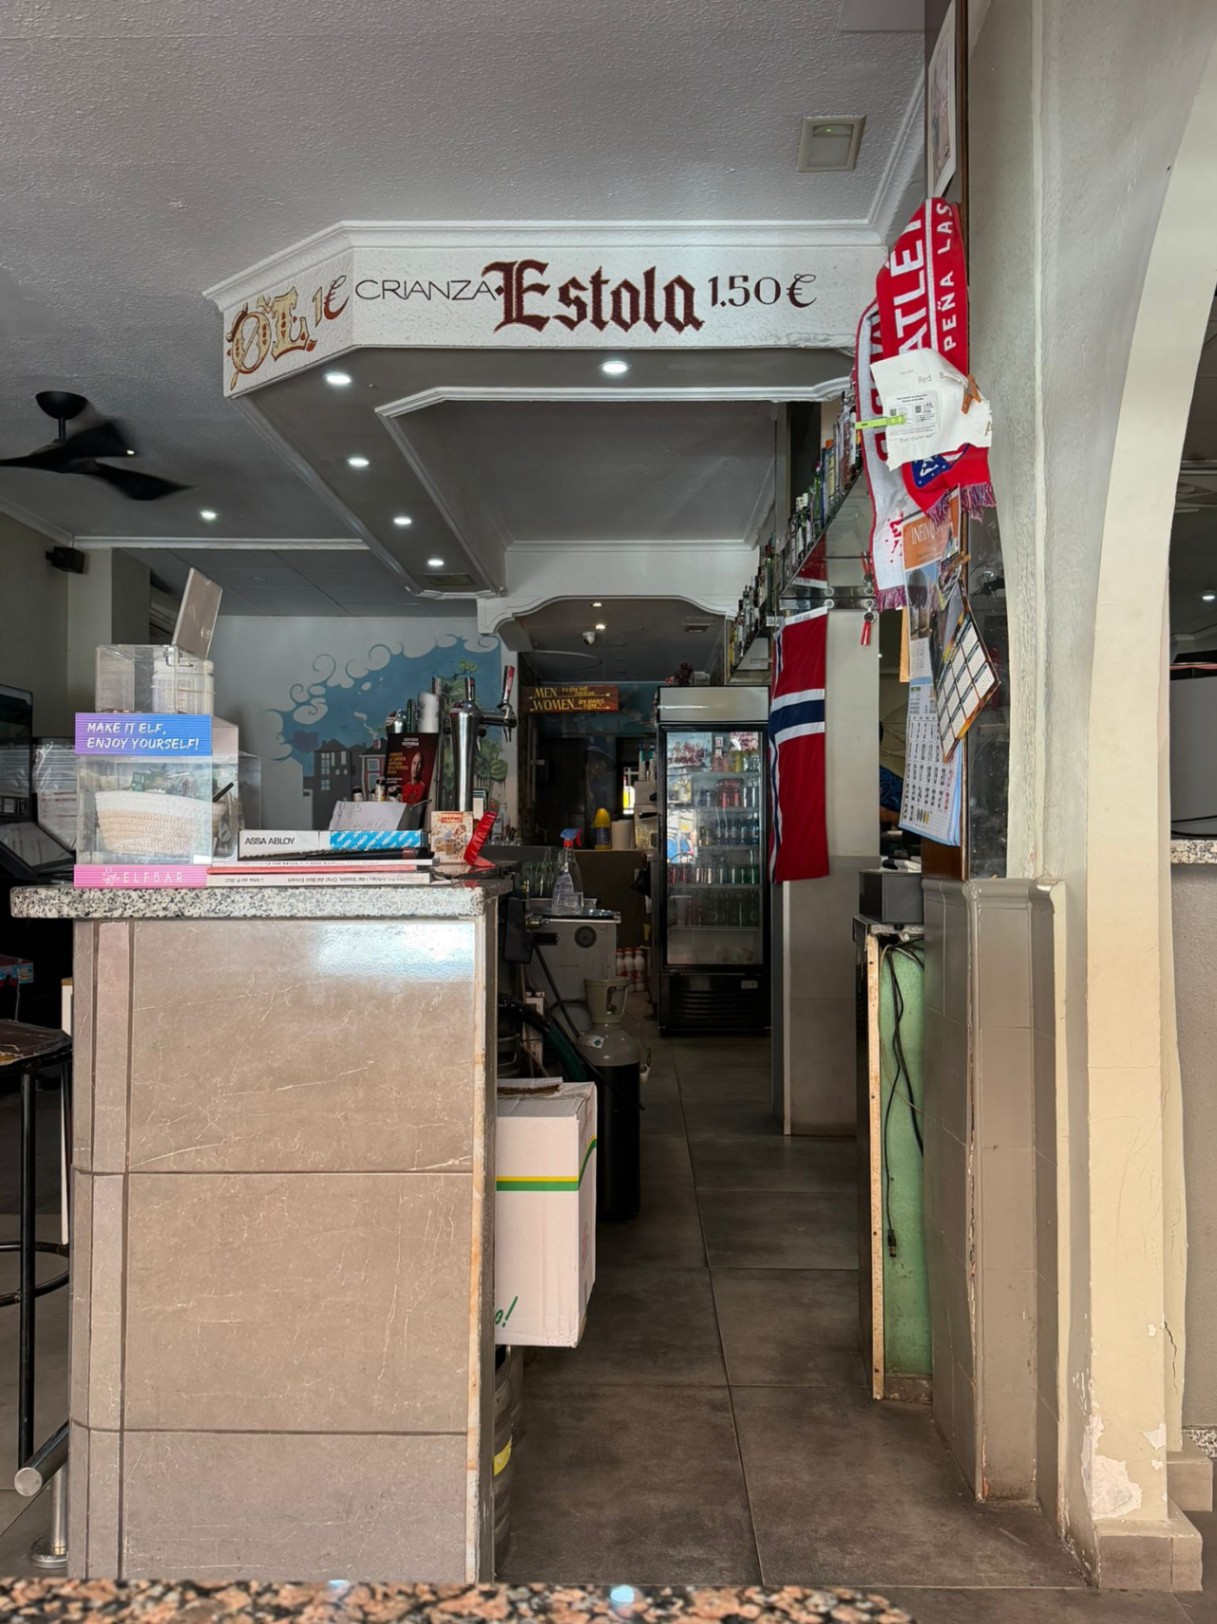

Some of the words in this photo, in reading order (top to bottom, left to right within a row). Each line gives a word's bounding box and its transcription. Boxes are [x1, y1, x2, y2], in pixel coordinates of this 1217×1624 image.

[936, 203, 955, 255] LAS
[354, 279, 498, 301] CRIANZA
[480, 258, 706, 335] Estola
[936, 270, 958, 353] PEÑA
[535, 687, 558, 698] MEN
[532, 699, 576, 711] WOMEN
[86, 722, 122, 735] MAKE
[123, 722, 137, 735] IT
[137, 722, 168, 737] ELF,
[86, 737, 130, 751] ENJOY
[130, 737, 201, 751] YOURSELF!
[244, 837, 268, 846] ASSA
[268, 837, 296, 846] ABLOY
[123, 872, 184, 884] ELFBAR
